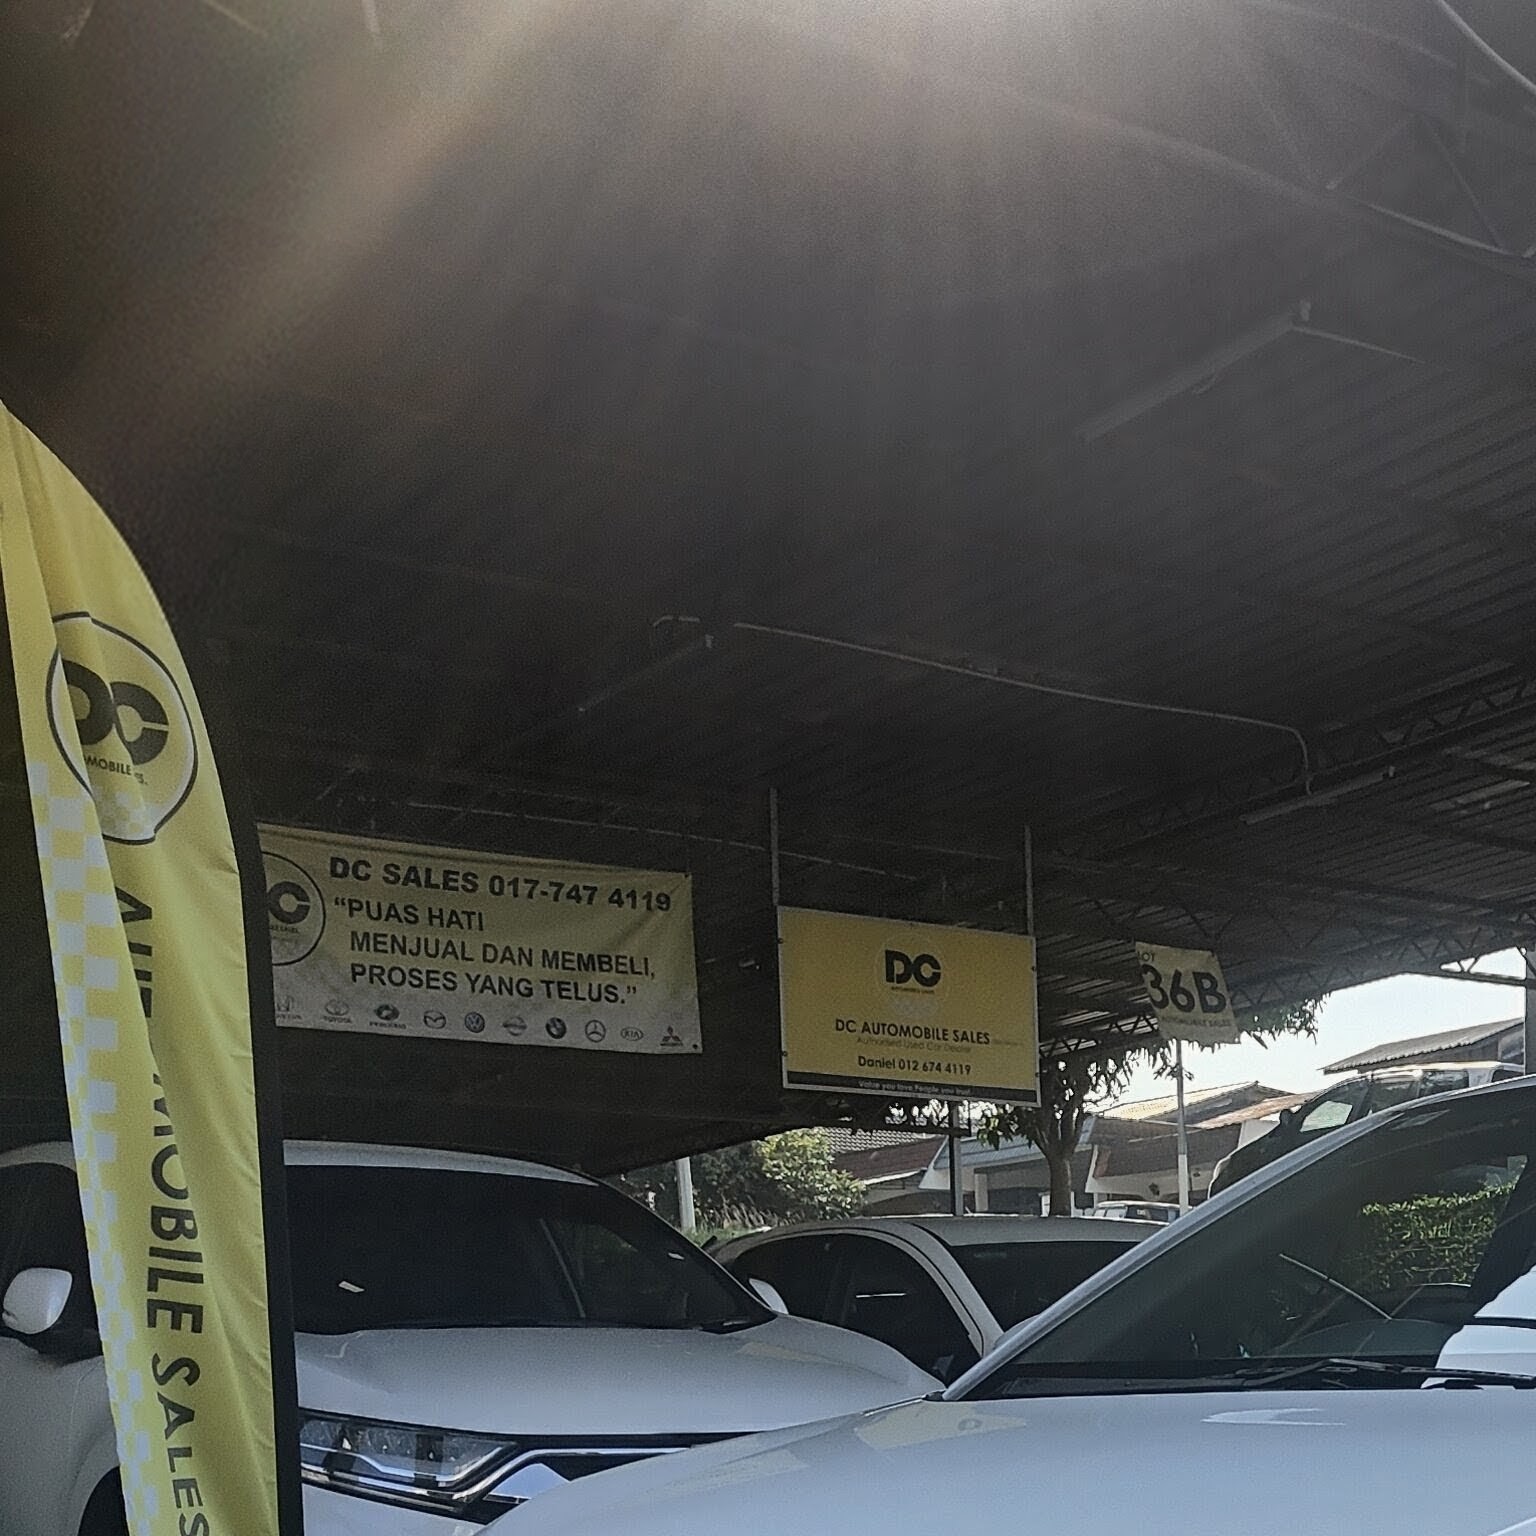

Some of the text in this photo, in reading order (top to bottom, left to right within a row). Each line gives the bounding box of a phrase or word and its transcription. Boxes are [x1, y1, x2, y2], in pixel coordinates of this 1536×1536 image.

[330, 856, 671, 912] DC SALES 017-747 4119
[427, 907, 485, 932] HATI
[350, 931, 656, 979] MENJUAL DAN MEMBELI,
[884, 949, 942, 987] DC
[350, 963, 458, 991] PROSES
[466, 974, 534, 998] YANG
[1141, 964, 1226, 1013] 36B
[835, 1018, 857, 1033] DC
[861, 1021, 949, 1042] AUTOMOBILE
[952, 1029, 990, 1045] SALES
[858, 1055, 971, 1075] Daniel 012 674 4119
